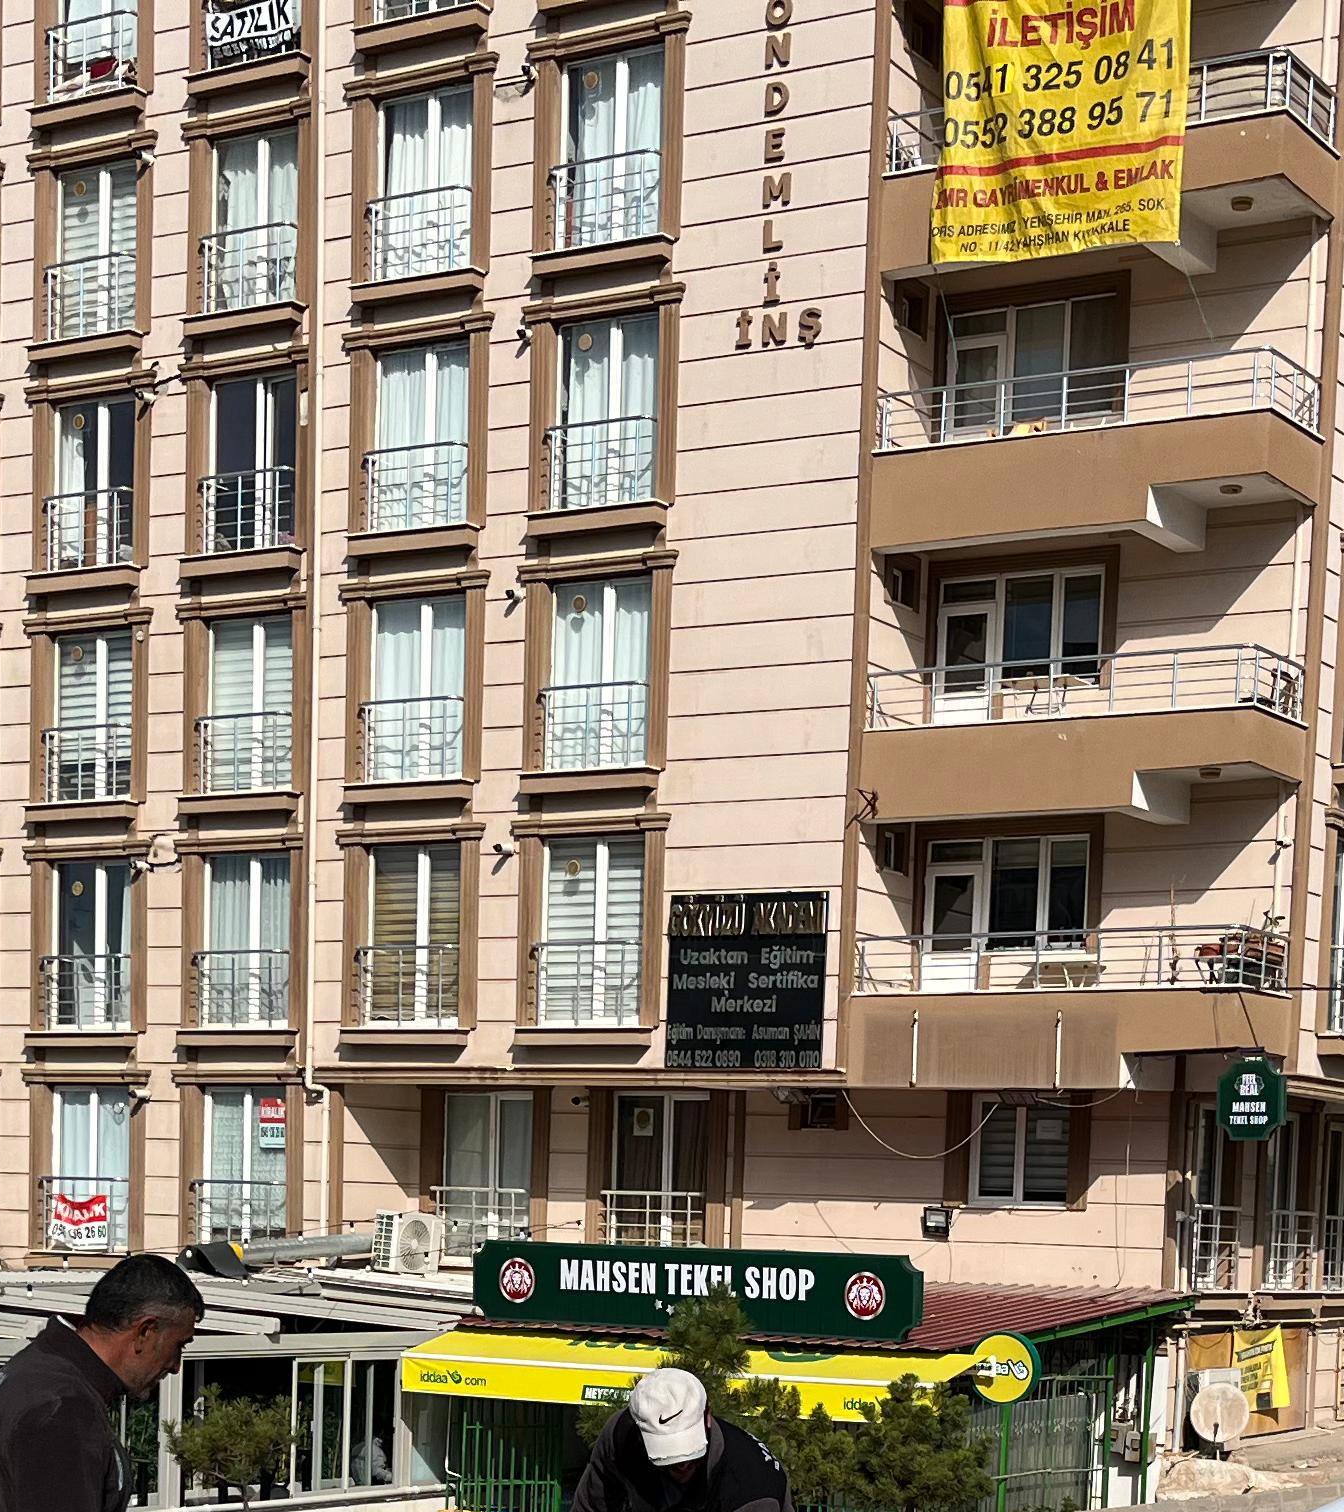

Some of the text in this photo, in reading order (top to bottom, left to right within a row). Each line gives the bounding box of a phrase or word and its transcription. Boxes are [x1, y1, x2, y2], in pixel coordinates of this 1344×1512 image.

[987, 0, 1136, 50] İLETİŞİM
[945, 38, 1174, 102] 0541 325 08 41
[943, 89, 1173, 149] 0552 388 95 71
[1095, 171, 1110, 192] &
[679, 945, 815, 969] Uzaktan Eğitim
[672, 971, 819, 990] Mesleki Sertifika
[711, 994, 777, 1013] Merkezi
[752, 1024, 790, 1040] Asuman
[667, 1050, 692, 1067] 0544
[695, 1050, 713, 1067] 522
[1232, 1101, 1267, 1113] MAHSEN
[560, 1258, 815, 1301] MAHSEN TEKEL SHOP
